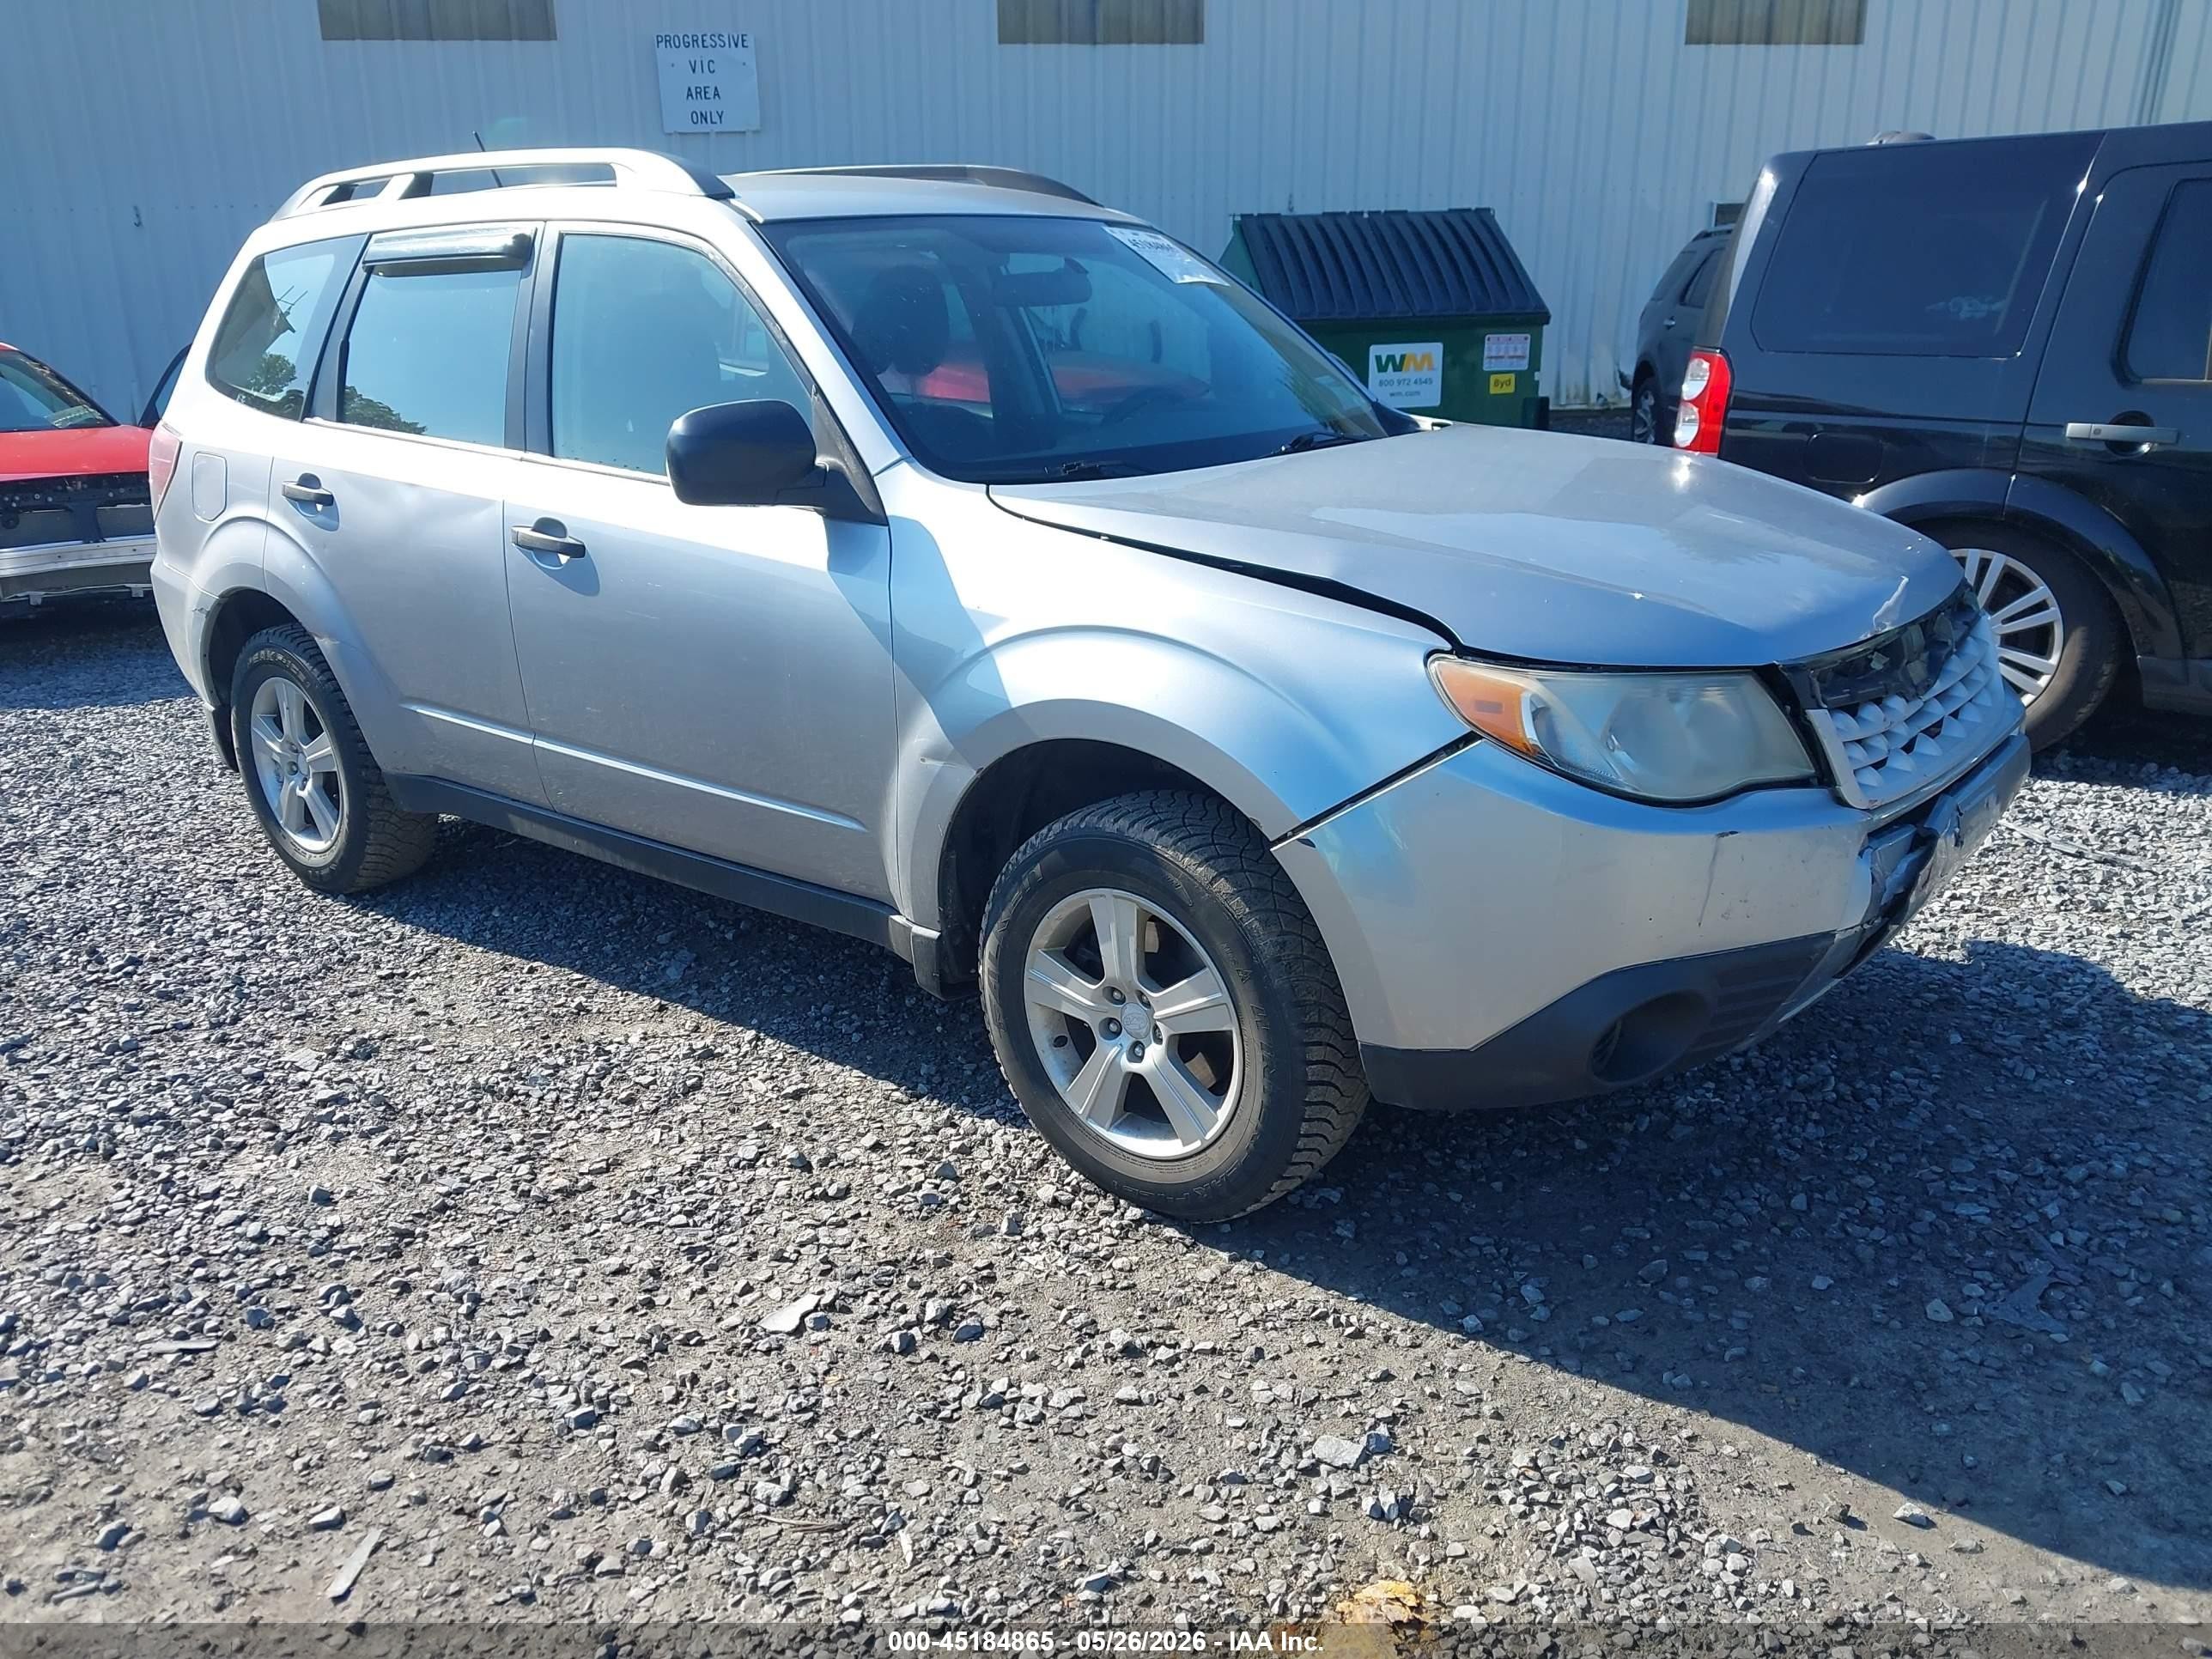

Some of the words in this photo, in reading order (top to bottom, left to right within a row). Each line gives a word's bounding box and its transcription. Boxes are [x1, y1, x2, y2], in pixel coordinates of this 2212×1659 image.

[656, 33, 749, 49] PROGRESSIVE
[688, 58, 715, 75] VIC
[686, 85, 721, 100] AREA
[690, 110, 724, 125] ONLY
[1374, 353, 1434, 373] WM
[1378, 378, 1395, 387] 800
[1397, 377, 1412, 386] 972
